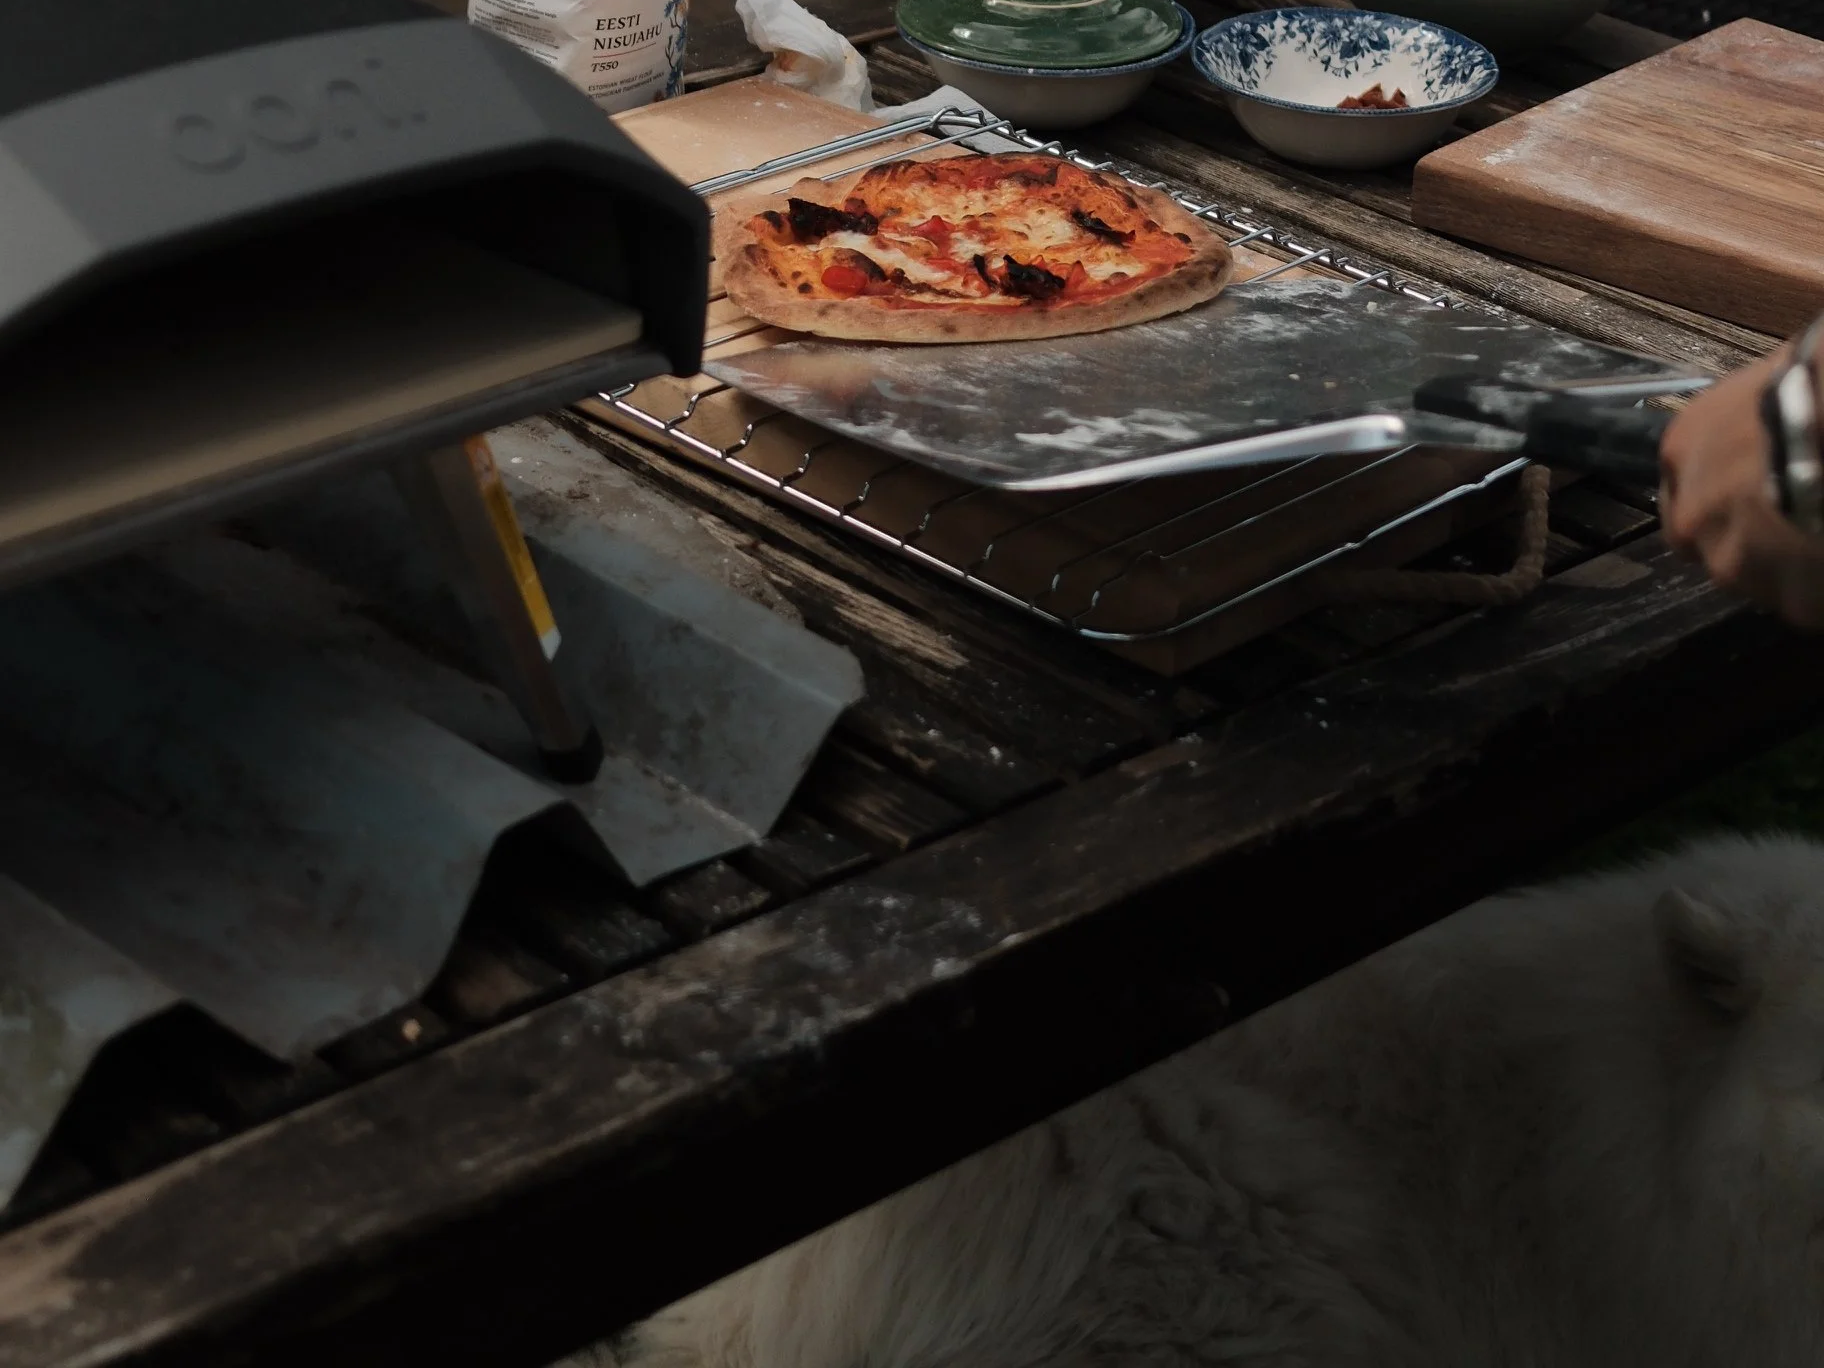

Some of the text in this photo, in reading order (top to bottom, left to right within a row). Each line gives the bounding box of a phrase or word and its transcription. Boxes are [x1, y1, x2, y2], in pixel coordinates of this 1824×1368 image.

[595, 13, 641, 31] EESTI
[593, 22, 663, 50] NISUJAHU
[591, 60, 619, 73] T550
